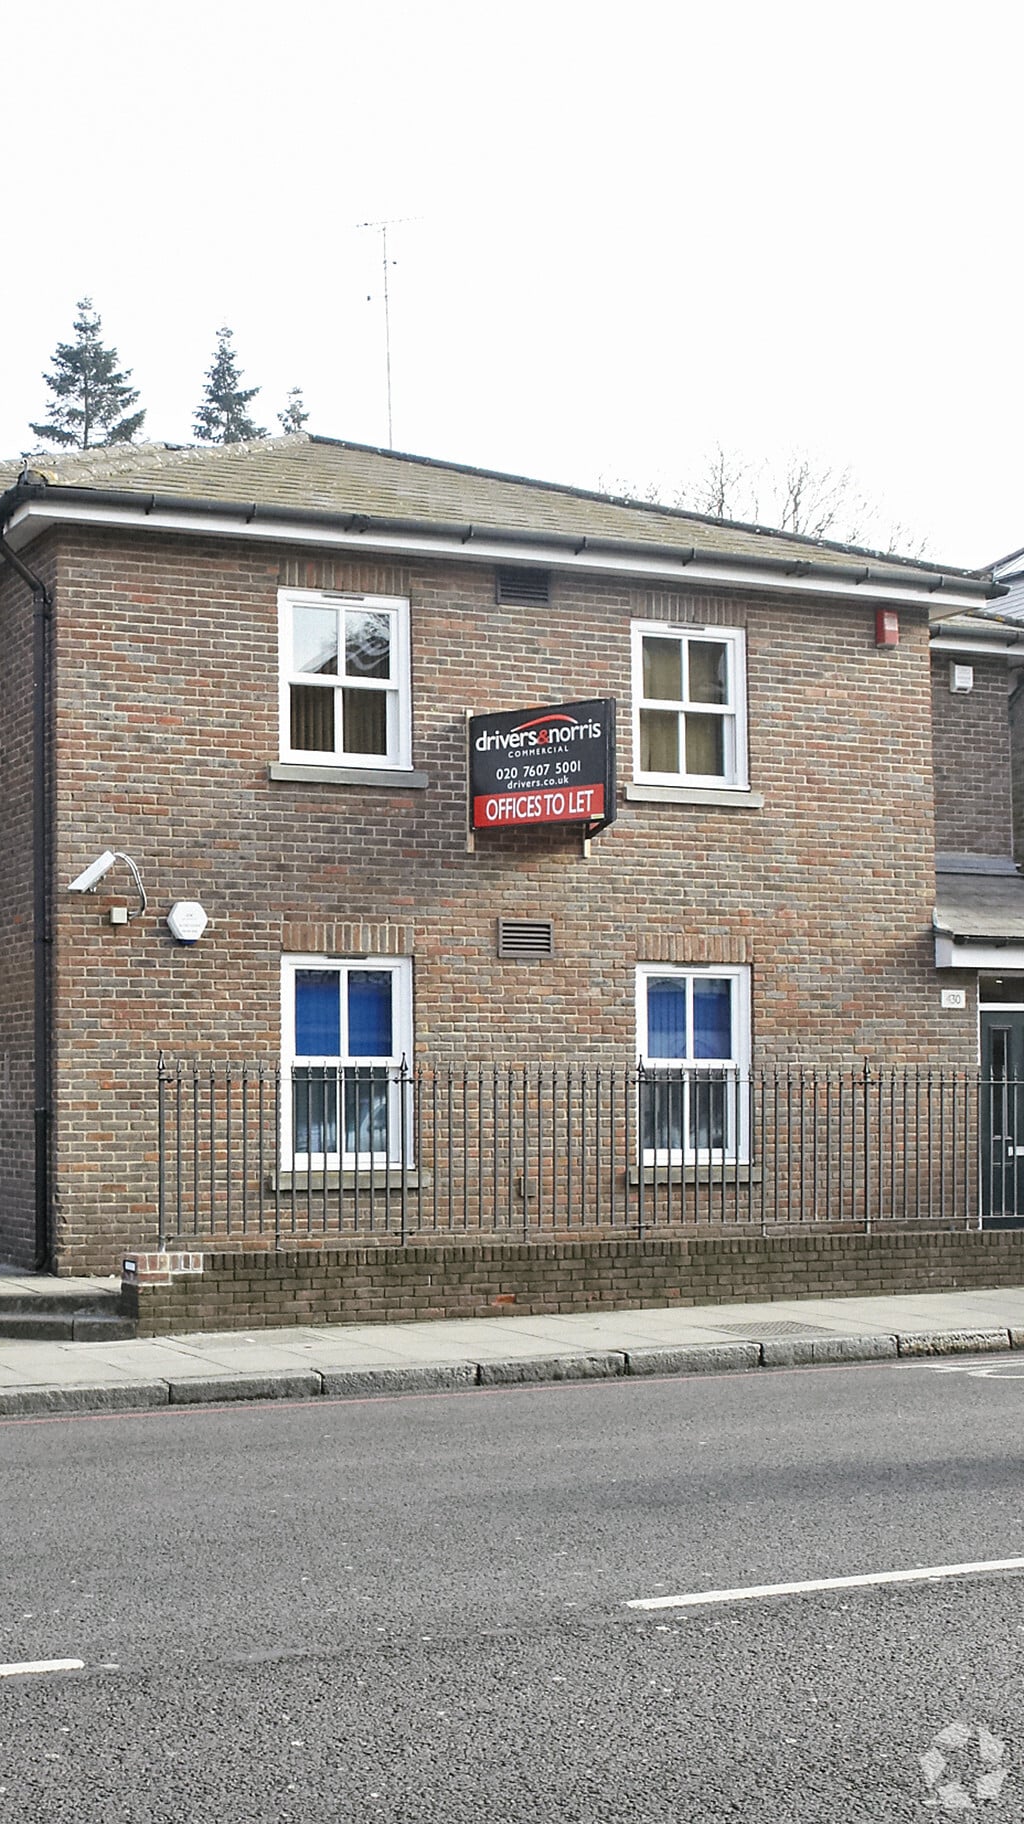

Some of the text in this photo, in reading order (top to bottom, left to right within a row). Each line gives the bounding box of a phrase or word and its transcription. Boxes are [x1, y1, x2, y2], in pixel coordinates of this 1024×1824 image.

[508, 745, 569, 759] COMMERCIAL
[496, 760, 581, 781] 020 7607 5001
[507, 775, 569, 790] drivers.co.uk
[485, 789, 594, 821] OFFICES TO LET
